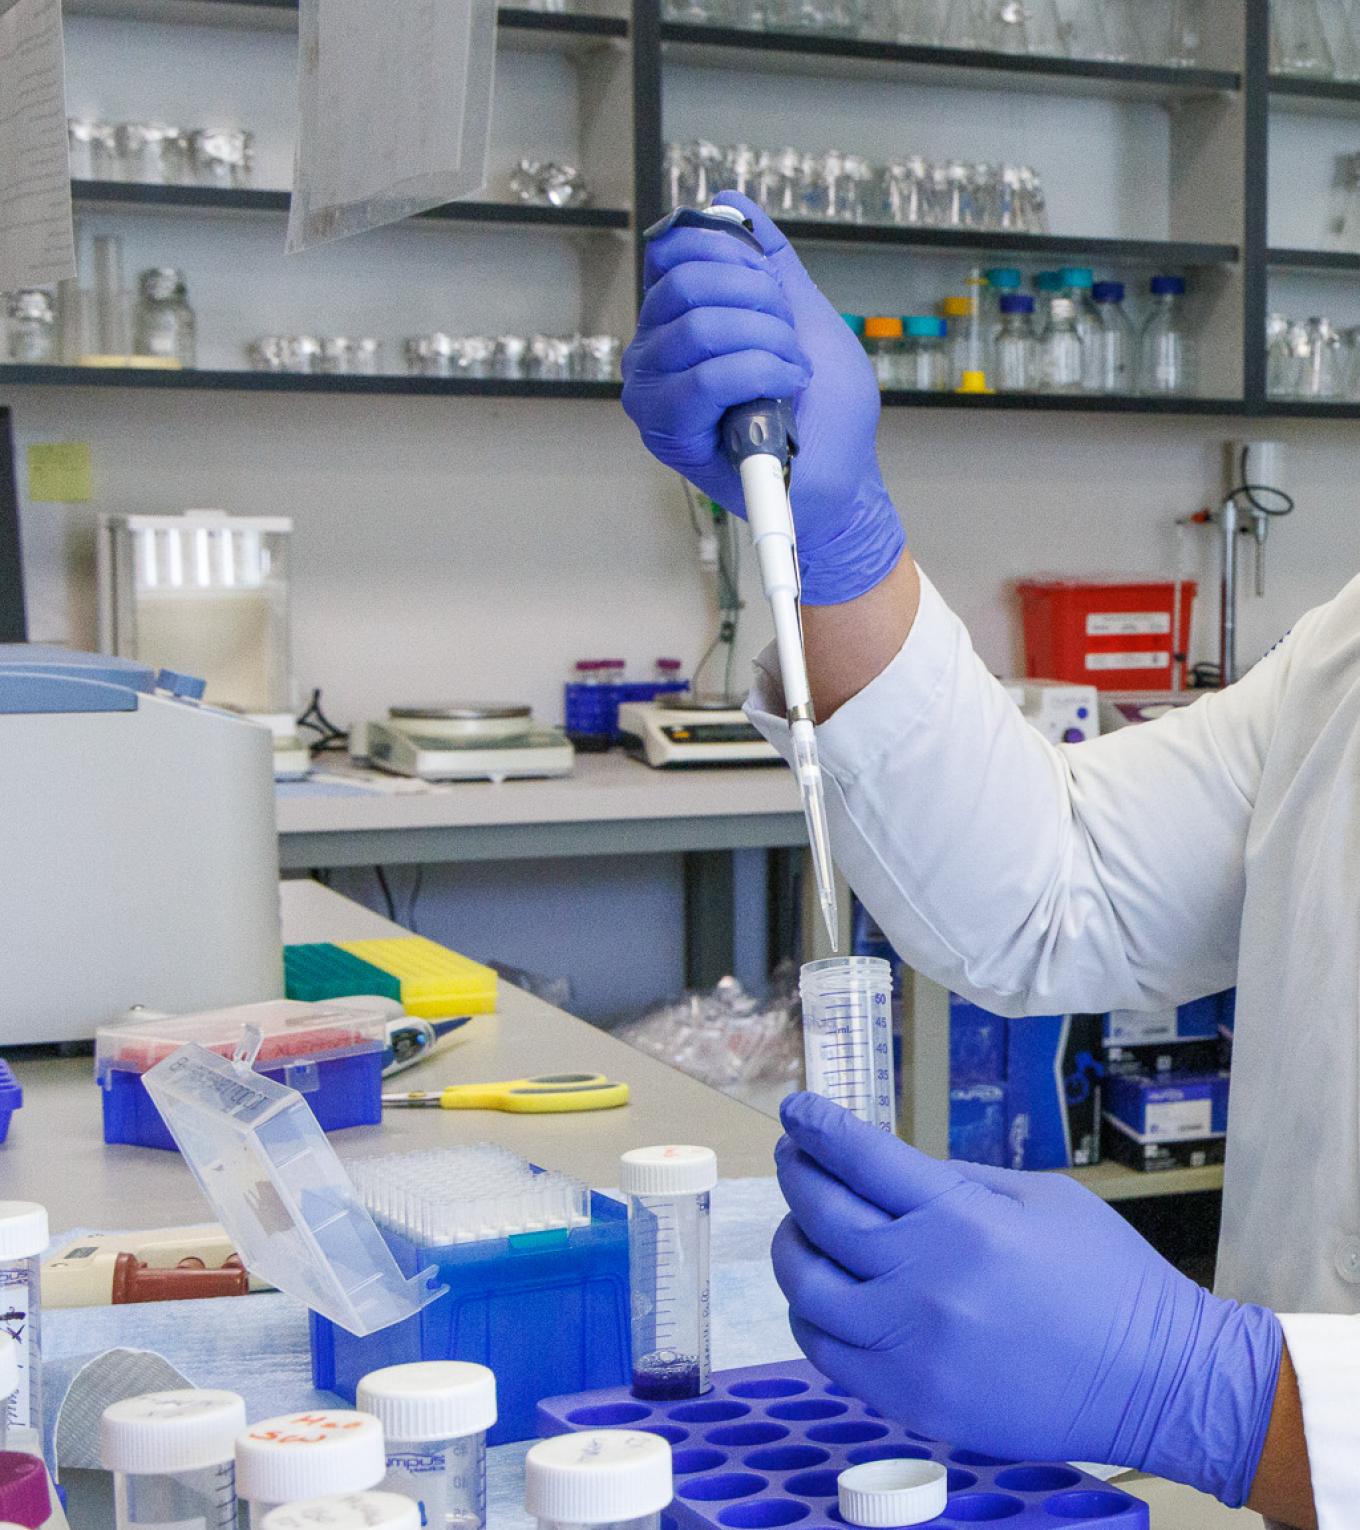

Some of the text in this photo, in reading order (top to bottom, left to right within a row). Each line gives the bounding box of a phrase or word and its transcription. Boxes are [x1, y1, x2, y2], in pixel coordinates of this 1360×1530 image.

[874, 993, 887, 1005] 50
[874, 1016, 888, 1029] 45
[875, 1043, 888, 1055] 40
[877, 1069, 889, 1080] 35
[878, 1093, 890, 1107] 30
